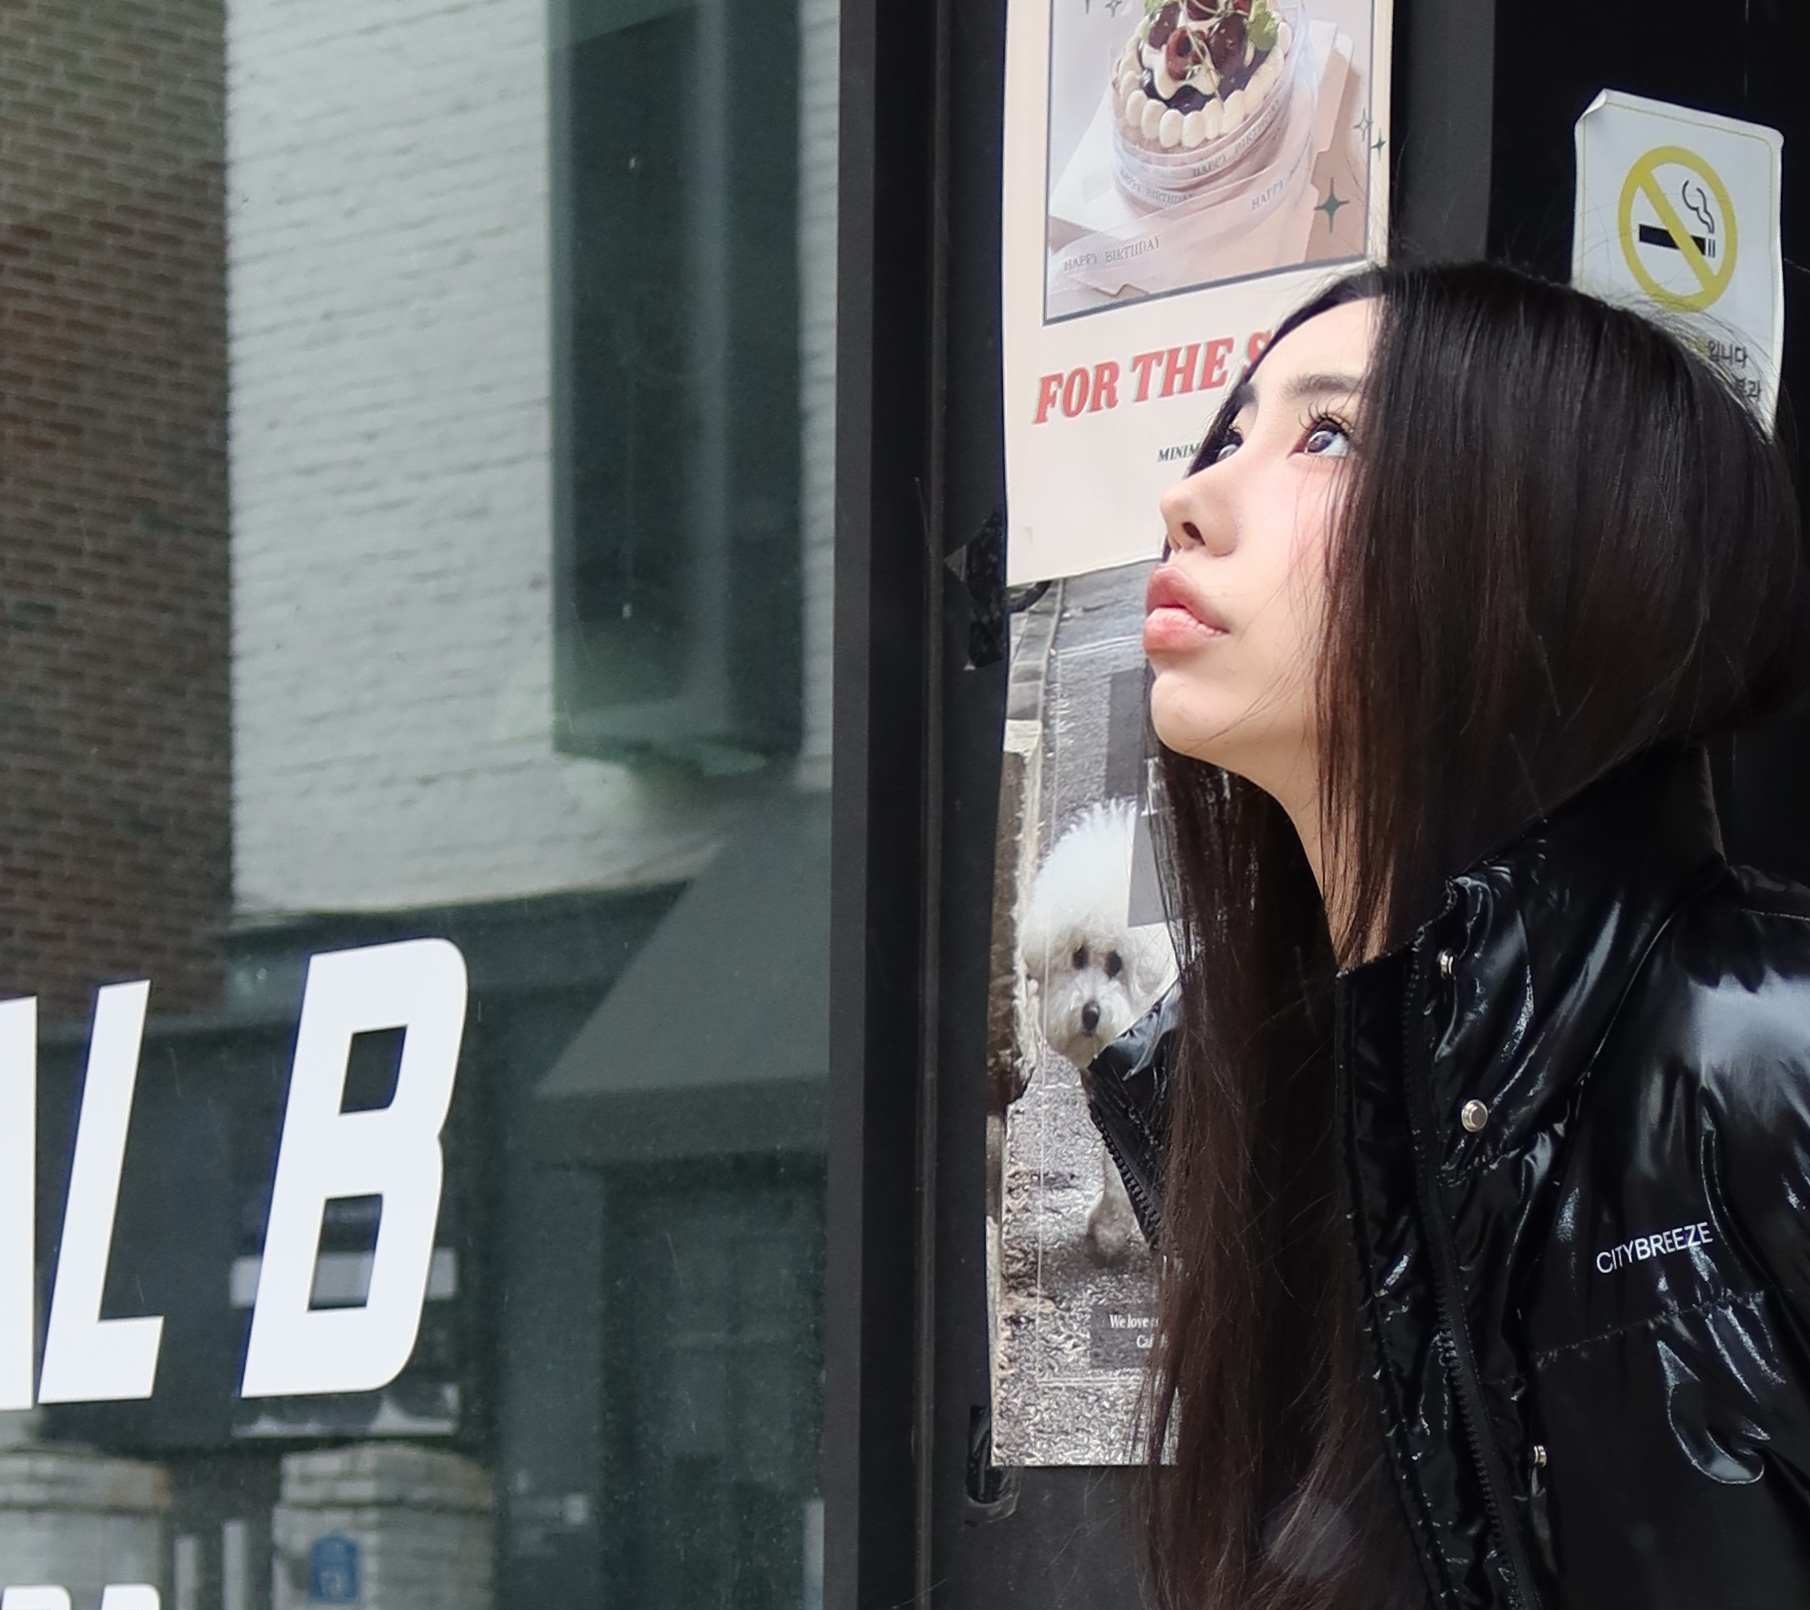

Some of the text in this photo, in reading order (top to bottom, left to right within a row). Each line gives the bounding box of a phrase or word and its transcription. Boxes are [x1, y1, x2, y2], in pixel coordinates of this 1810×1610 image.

[1063, 235, 1160, 272] HAPPY BIRTHDAY
[1032, 360, 1120, 425] FOR
[1131, 337, 1234, 403] THE
[241, 937, 469, 1398] B
[1596, 1221, 1714, 1274] CITYBREEZE
[1109, 1313, 1127, 1329] We
[1127, 1313, 1150, 1329] love
